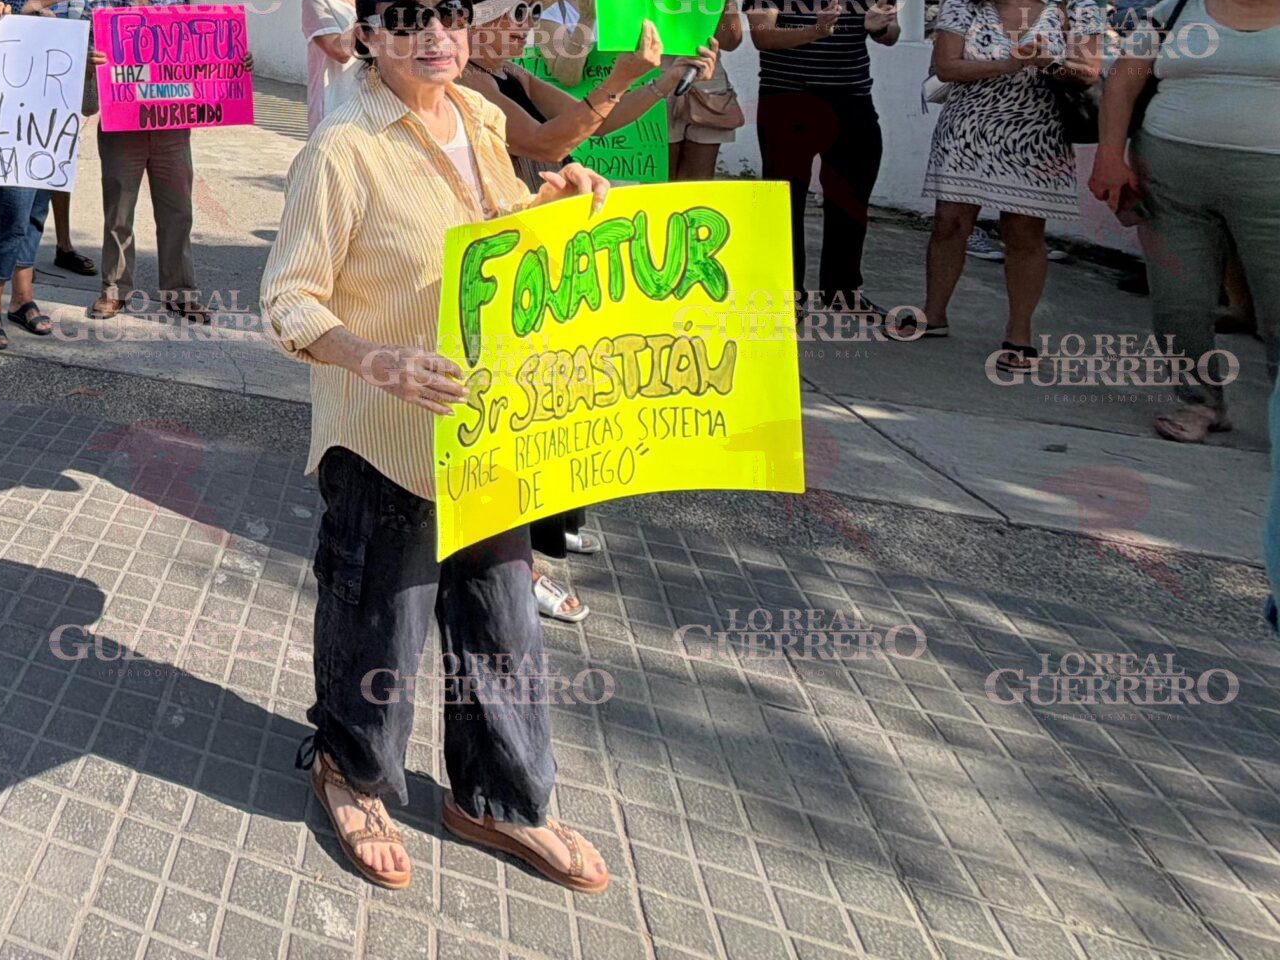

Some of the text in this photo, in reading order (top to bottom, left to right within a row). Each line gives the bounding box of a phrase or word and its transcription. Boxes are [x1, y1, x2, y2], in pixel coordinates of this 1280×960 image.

[110, 12, 246, 65] FONATUR
[114, 63, 244, 82] HAZ INCUMPLIDO
[137, 83, 191, 99] VENADOS
[138, 103, 223, 129] MURIENDO
[458, 205, 730, 369] FONATUR
[637, 406, 729, 442] SISTEMA
[518, 476, 546, 516] DE
